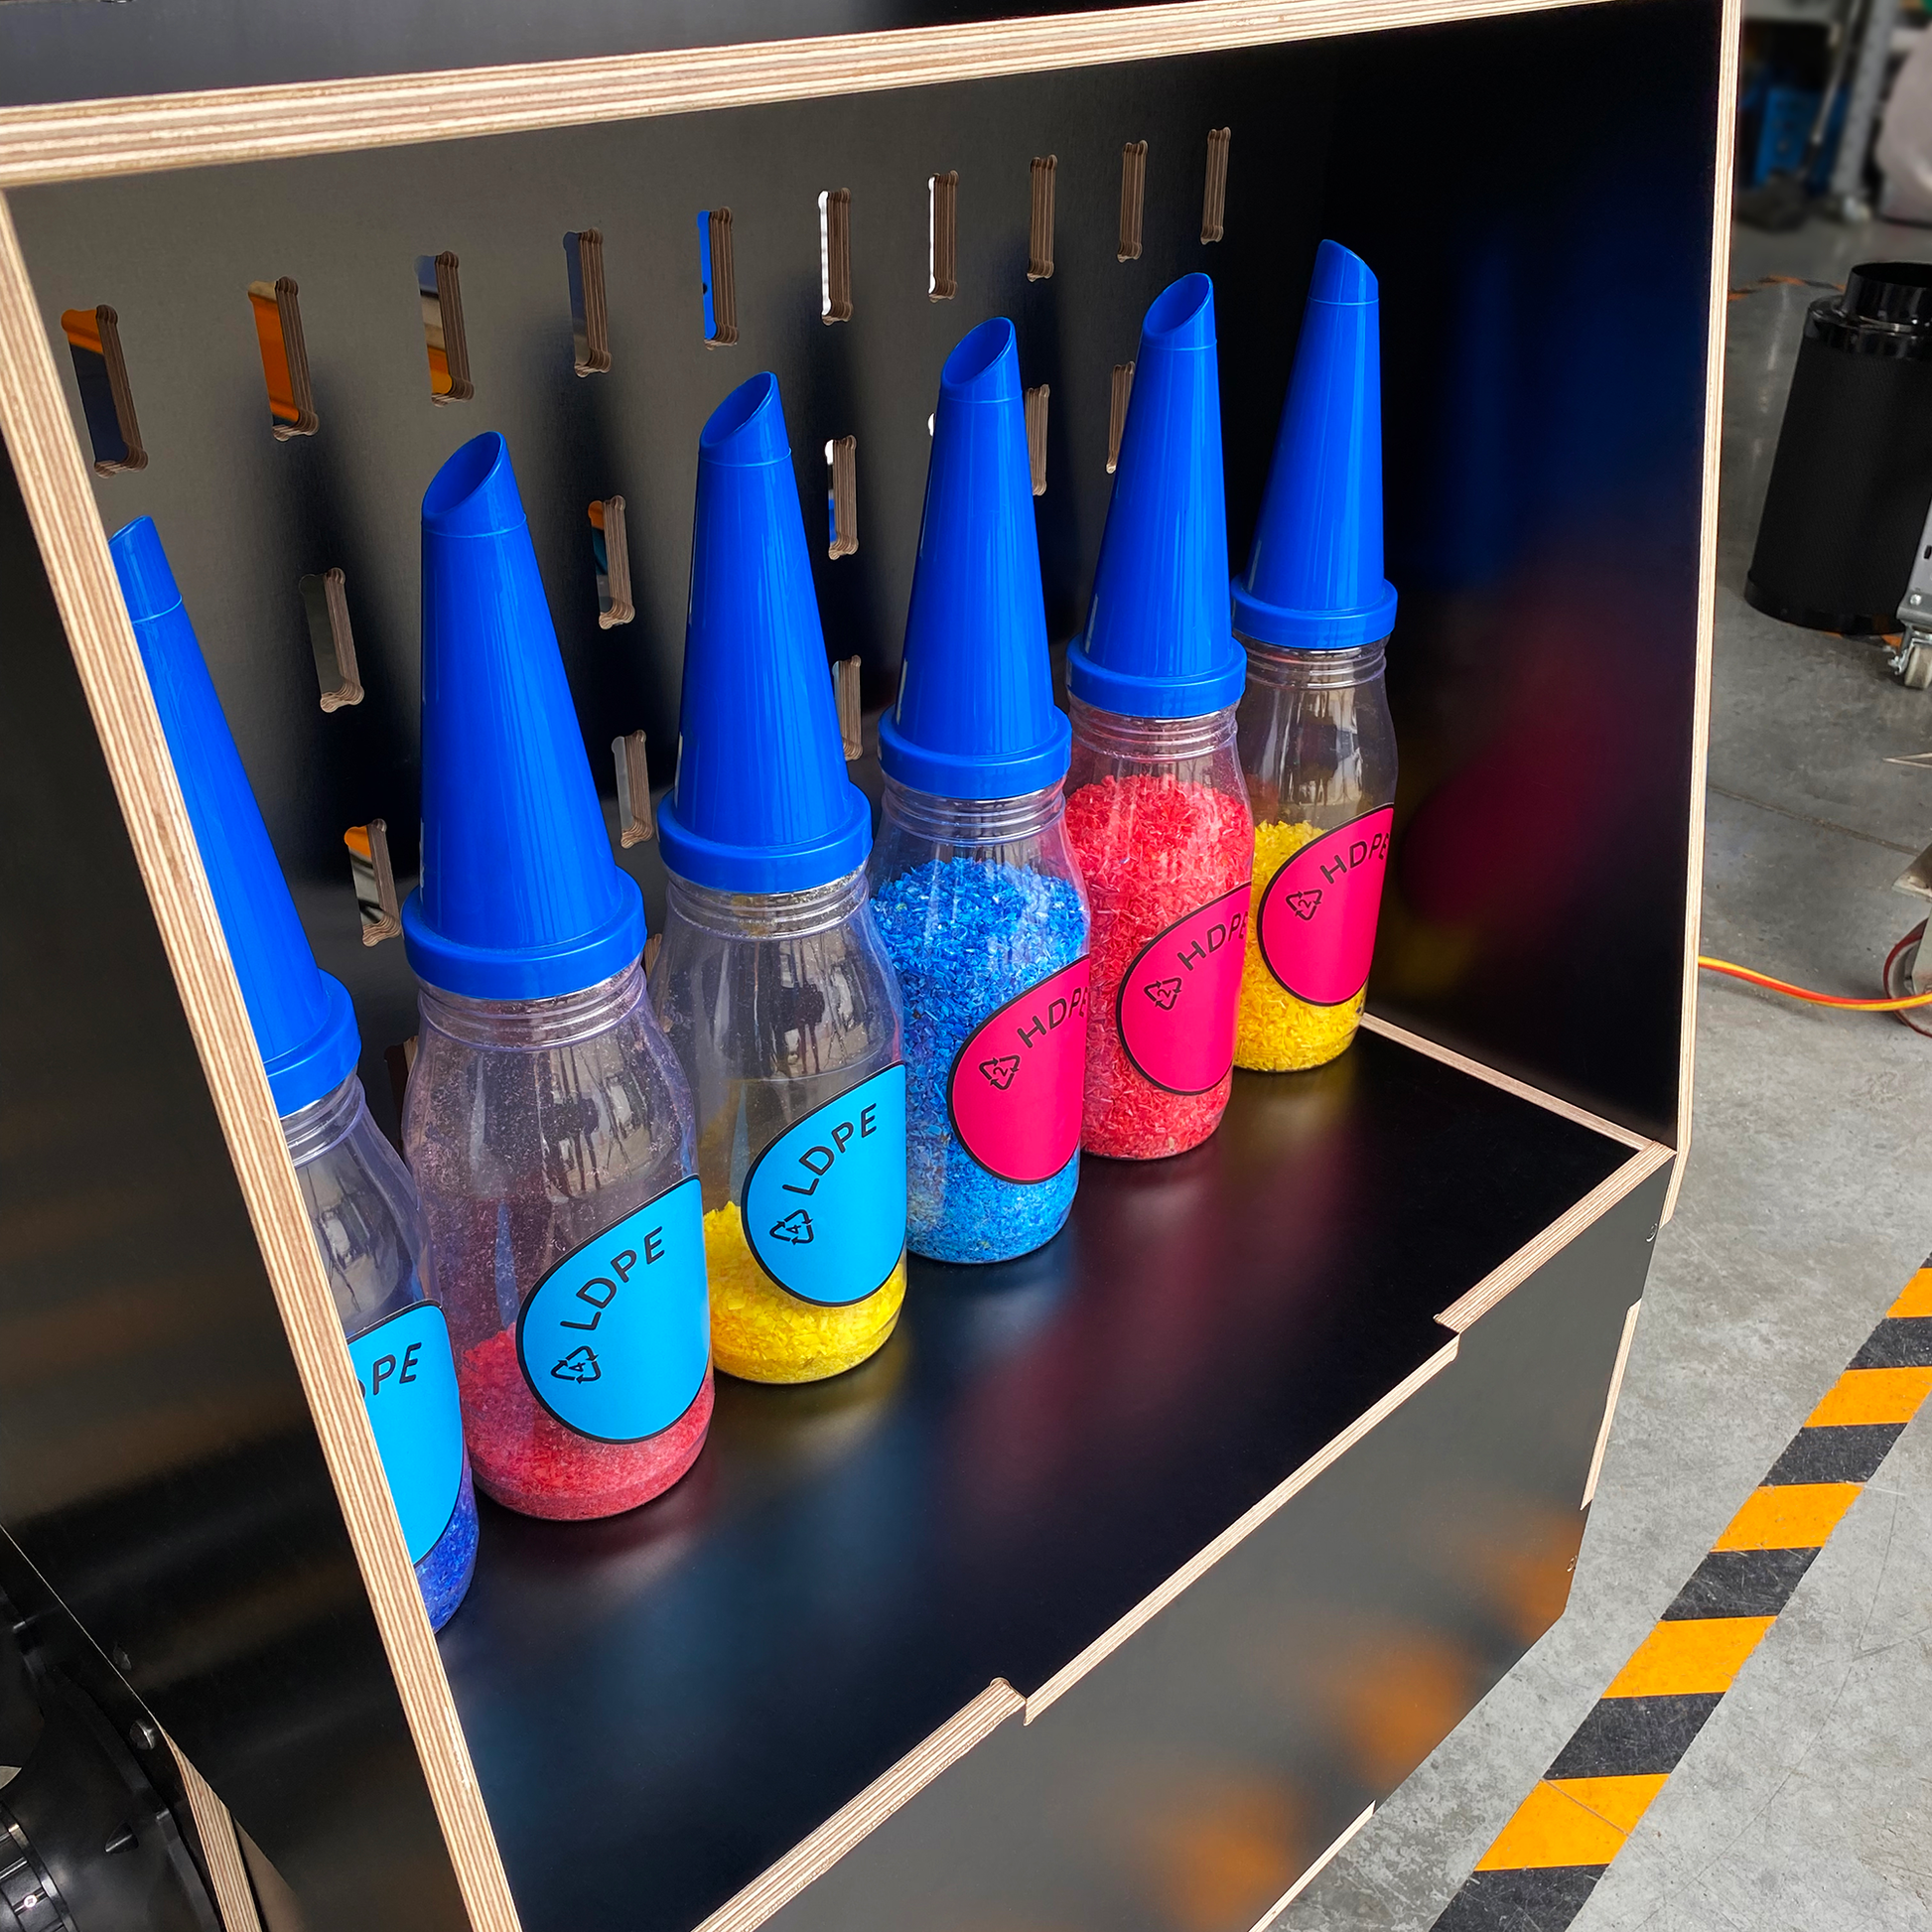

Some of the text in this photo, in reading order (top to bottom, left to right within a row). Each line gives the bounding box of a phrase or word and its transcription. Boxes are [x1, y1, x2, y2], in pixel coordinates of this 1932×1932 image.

[781, 1103, 877, 1195] LDPE
[559, 1226, 665, 1330] LDPE
[357, 1341, 422, 1400] PE
